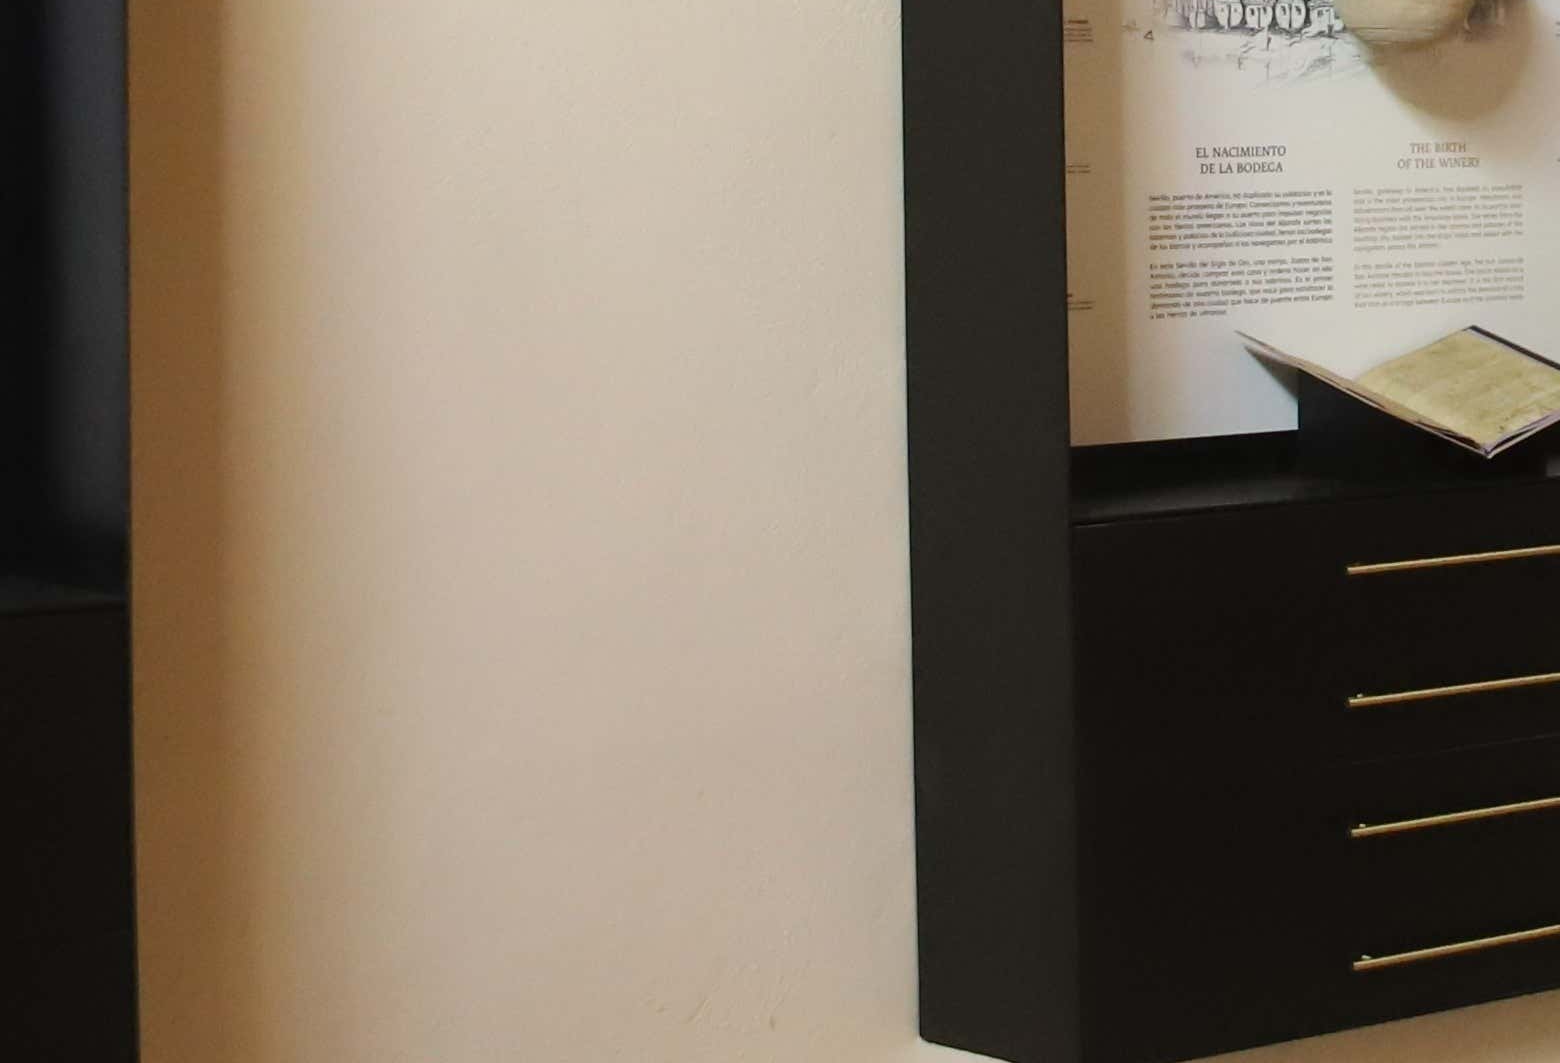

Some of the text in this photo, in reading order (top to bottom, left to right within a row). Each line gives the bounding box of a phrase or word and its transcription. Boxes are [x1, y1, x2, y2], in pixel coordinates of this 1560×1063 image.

[1195, 145, 1287, 158] EL NACIMIENTO
[1200, 162, 1216, 174] DE
[1219, 162, 1234, 173] LA
